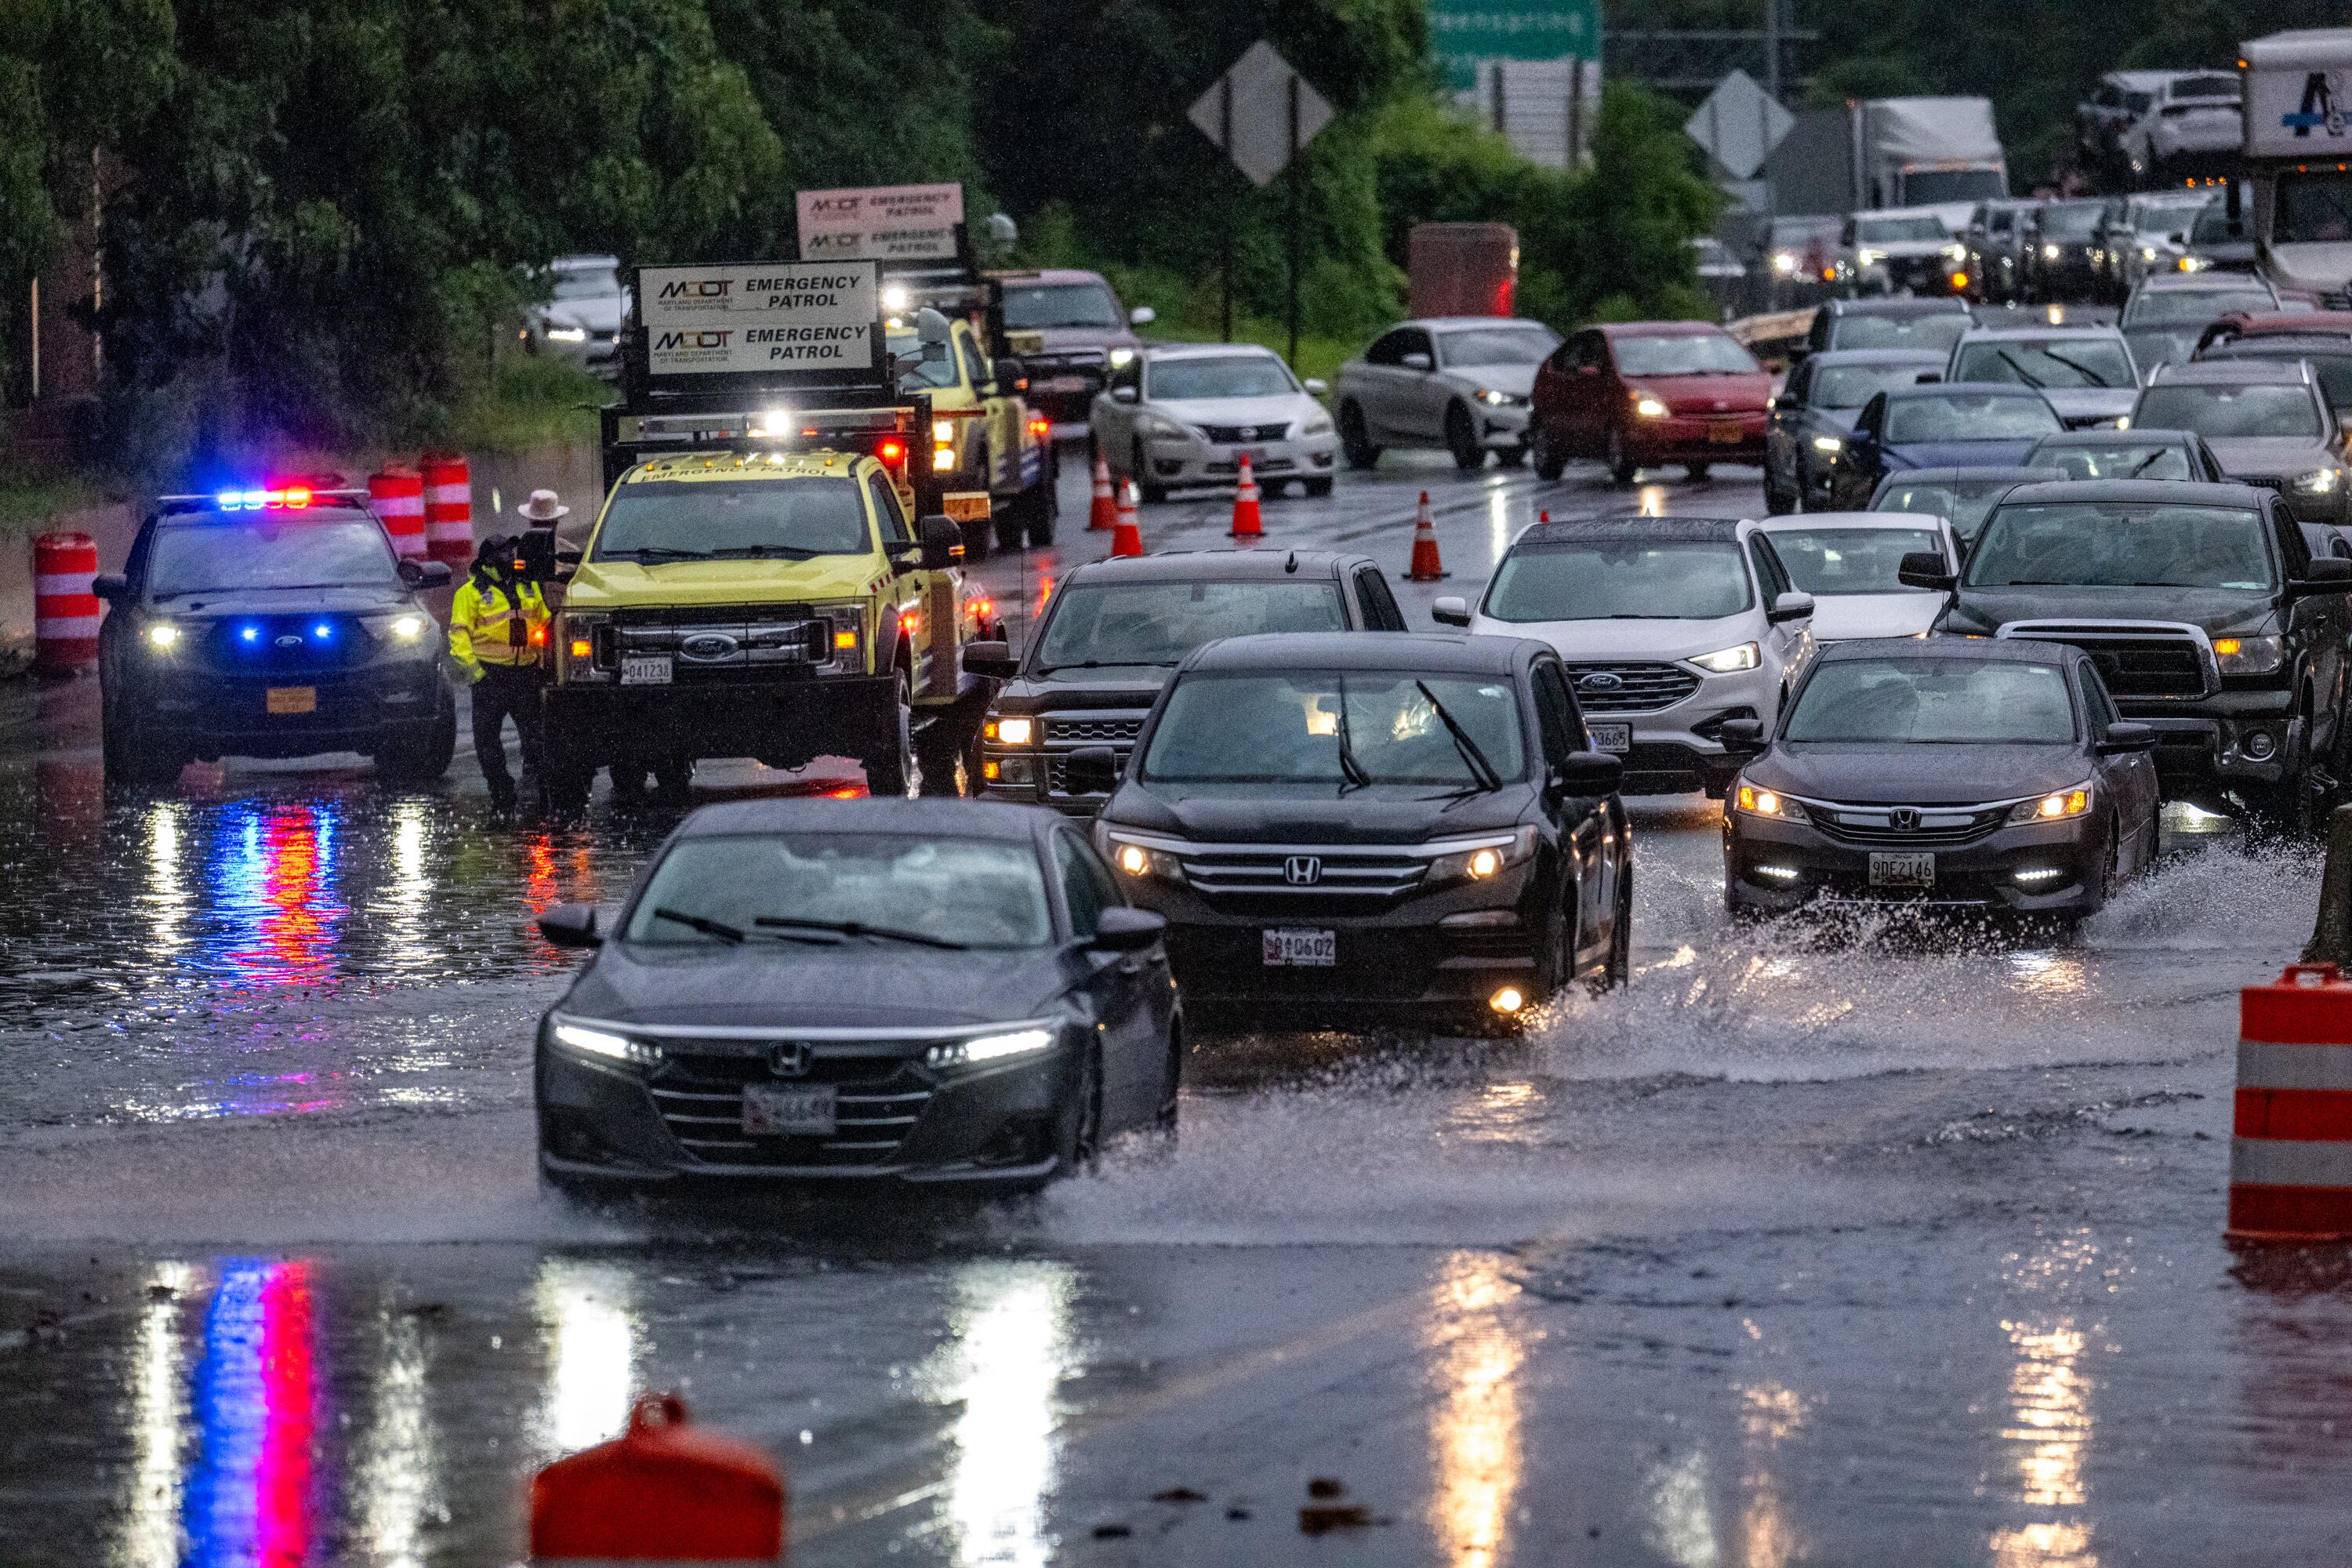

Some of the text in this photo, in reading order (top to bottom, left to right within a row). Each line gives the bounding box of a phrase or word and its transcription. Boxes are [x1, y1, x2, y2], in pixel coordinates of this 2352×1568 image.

[869, 194, 950, 205] EMERGENCY
[886, 205, 935, 217] PATROL
[887, 242, 939, 253] PATROL
[746, 277, 860, 292] EMERGENCY
[768, 293, 838, 307] PATROL
[746, 326, 866, 343] EMERGENCY
[770, 345, 843, 359] PATROL
[641, 466, 829, 481] EMERGENCY PATROL
[1873, 861, 1932, 878] 9DE2146
